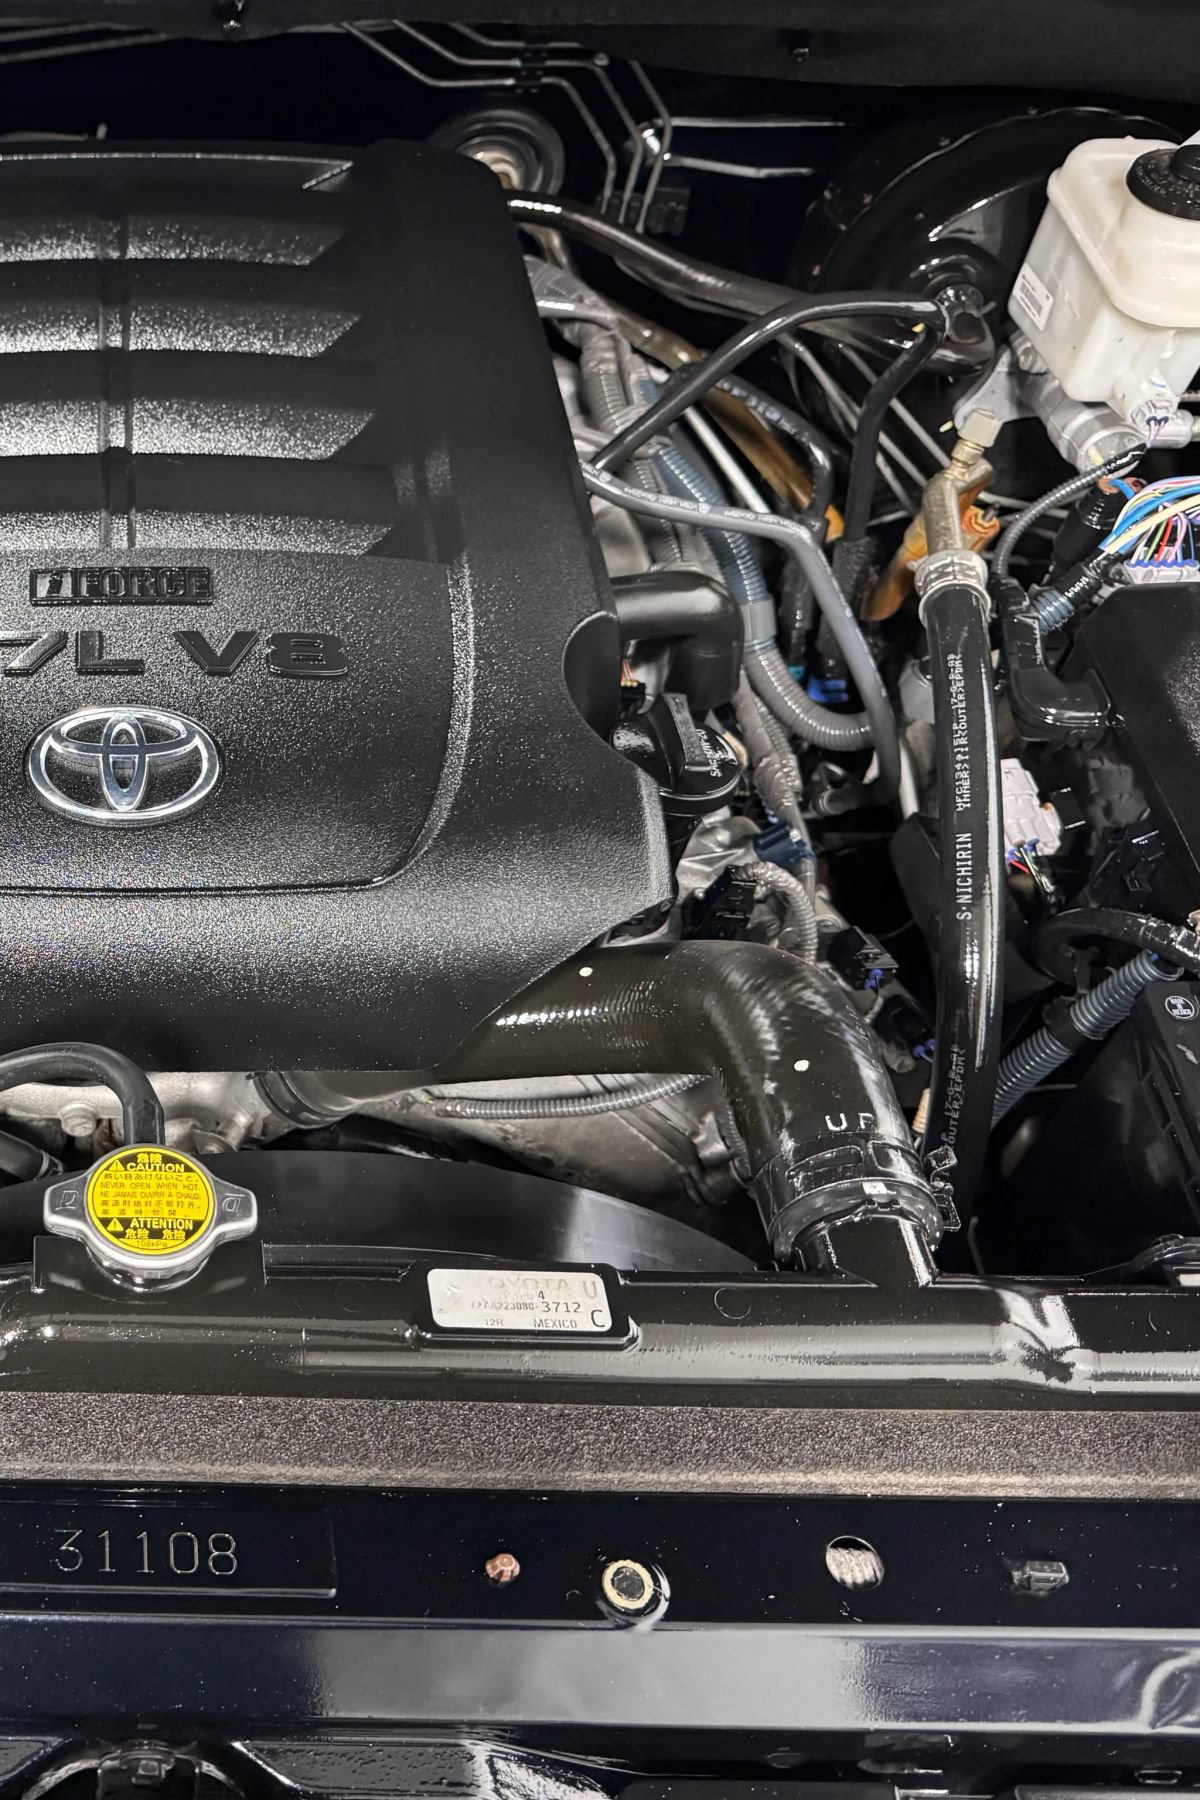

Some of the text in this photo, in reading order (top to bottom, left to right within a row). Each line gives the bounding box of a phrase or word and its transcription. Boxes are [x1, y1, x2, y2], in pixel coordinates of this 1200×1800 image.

[173, 631, 348, 678] V8
[126, 1162, 185, 1173] CAUTION
[140, 1191, 165, 1199] OUVRIR
[130, 1218, 193, 1230] ATTENTION
[582, 1280, 598, 1300] U
[533, 1317, 578, 1329] MEXICO
[590, 1309, 606, 1328] C
[54, 1528, 238, 1575] 31108
